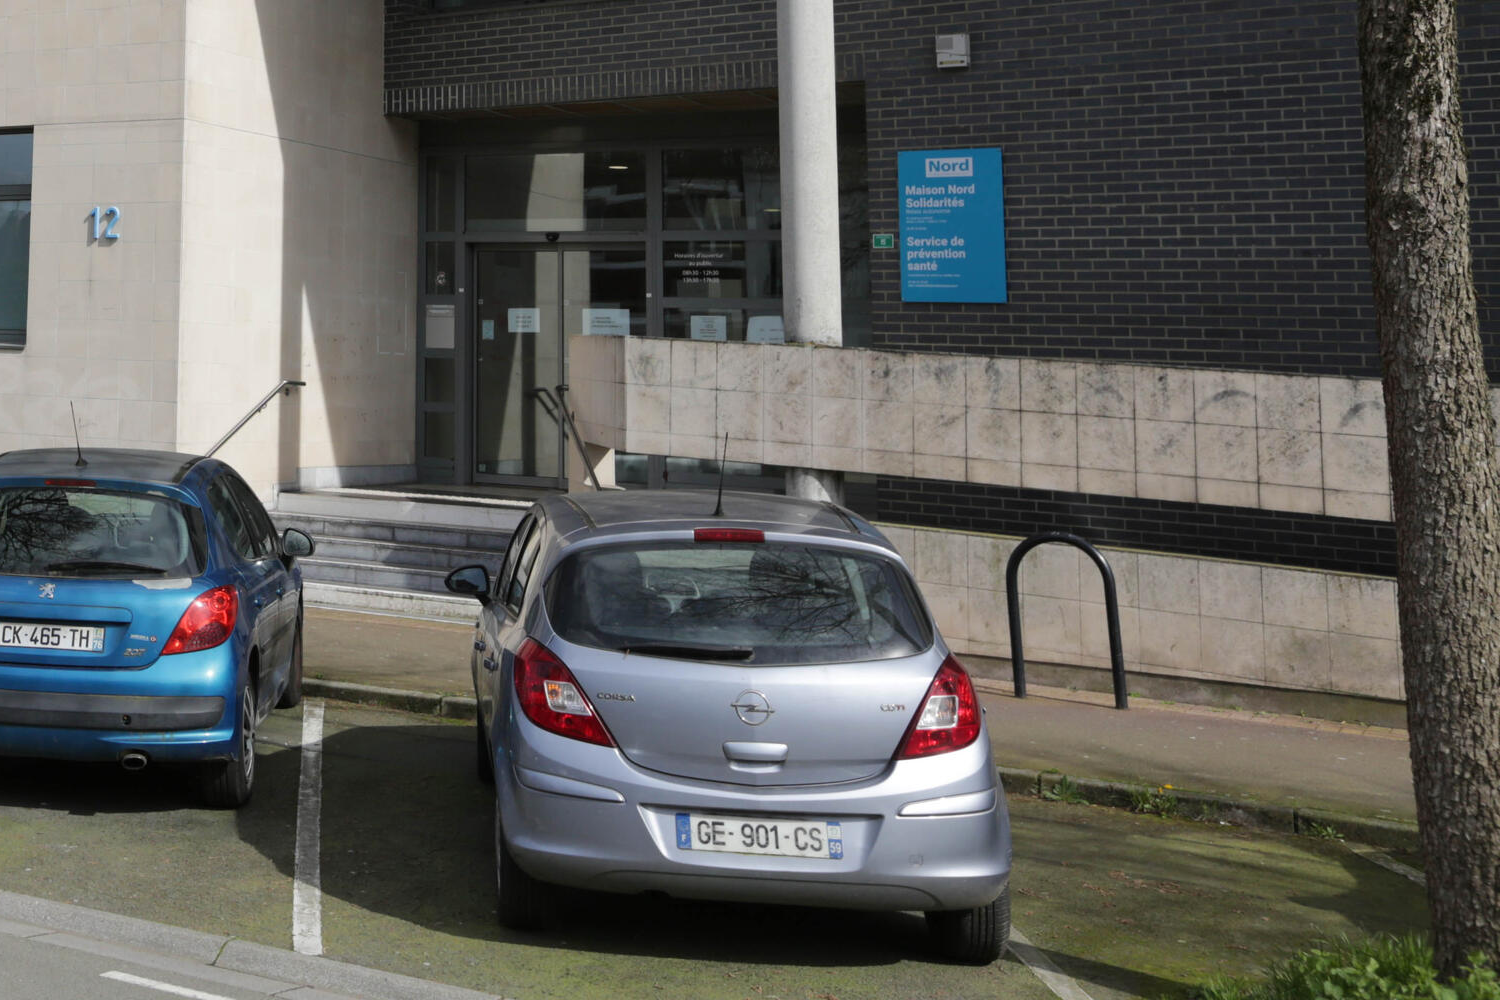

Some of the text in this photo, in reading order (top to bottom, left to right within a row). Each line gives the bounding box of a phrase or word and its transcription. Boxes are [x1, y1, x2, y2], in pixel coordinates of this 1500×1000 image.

[929, 159, 969, 172] Nord
[905, 184, 975, 195] Maison Nord
[906, 196, 964, 208] Solidarités
[90, 206, 120, 239] 12
[907, 236, 964, 247] Service de
[907, 248, 966, 261] prévention
[908, 260, 938, 271] santé
[596, 692, 636, 702] CORSA
[830, 842, 842, 855] 59
